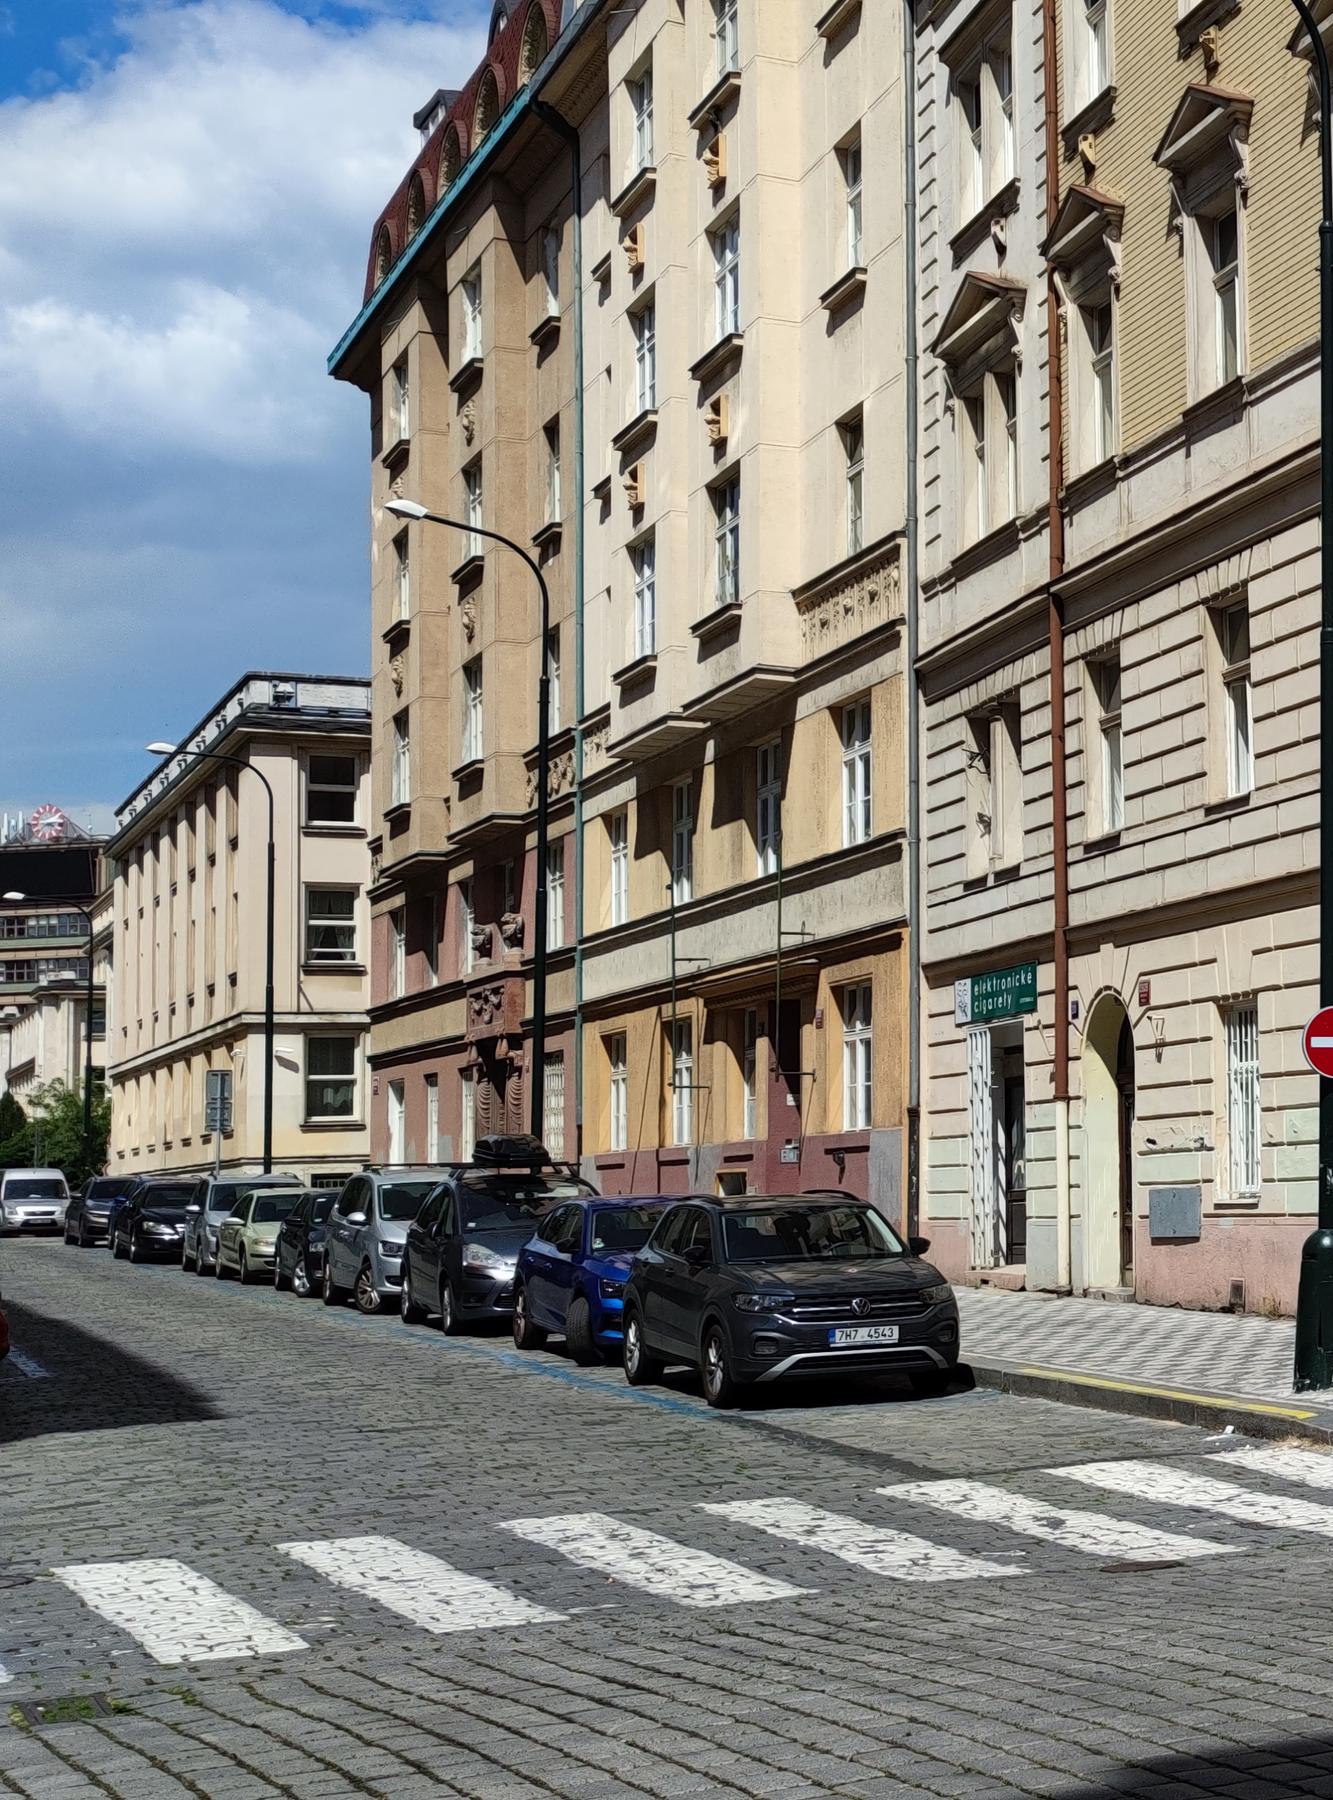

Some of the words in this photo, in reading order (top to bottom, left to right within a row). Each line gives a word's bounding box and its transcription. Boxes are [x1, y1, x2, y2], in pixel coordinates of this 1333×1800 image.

[973, 967, 1033, 996] elektronické
[973, 993, 1013, 1014] cigarety
[838, 1329, 858, 1341] 7H7
[867, 1327, 894, 1339] 4543
